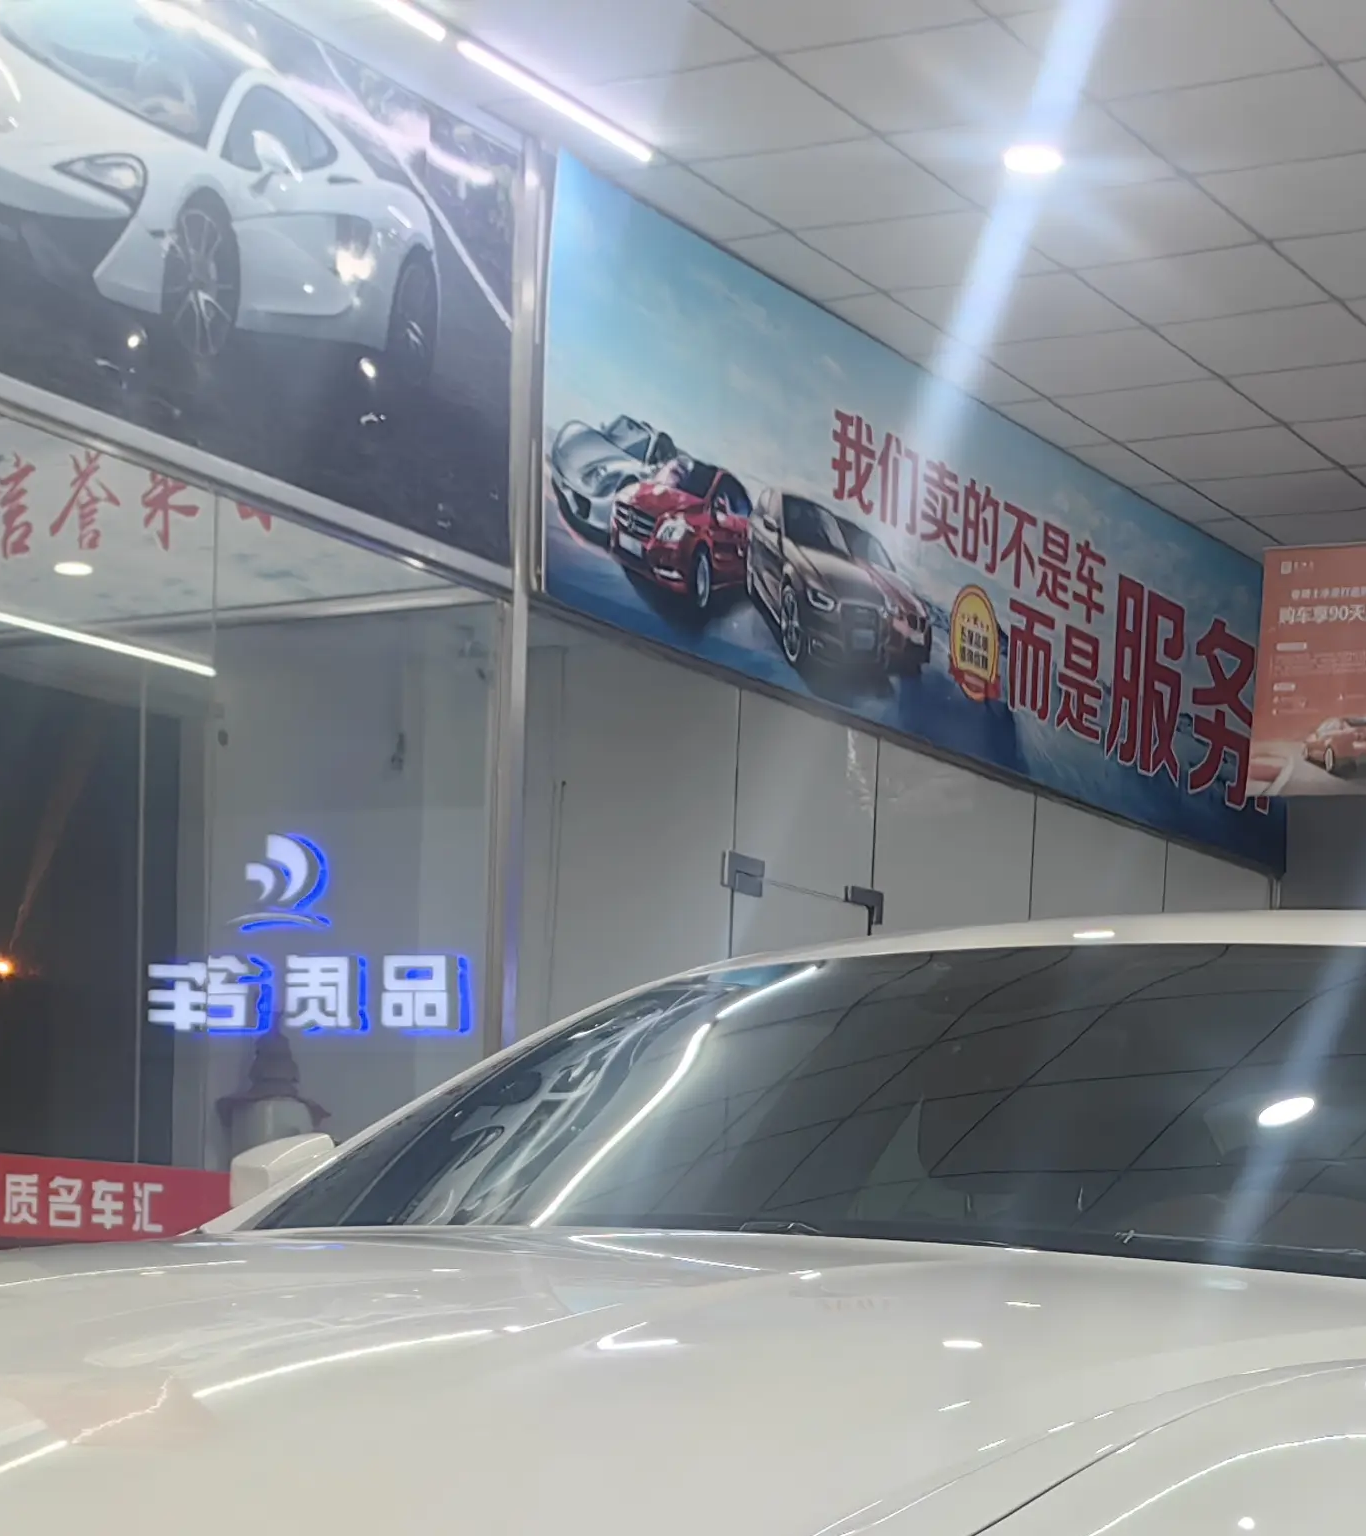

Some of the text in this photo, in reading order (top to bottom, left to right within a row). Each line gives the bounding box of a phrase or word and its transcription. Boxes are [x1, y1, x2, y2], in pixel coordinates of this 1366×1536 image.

[831, 409, 1106, 624] 我们卖的不是车
[1007, 573, 1270, 815] 而是服务
